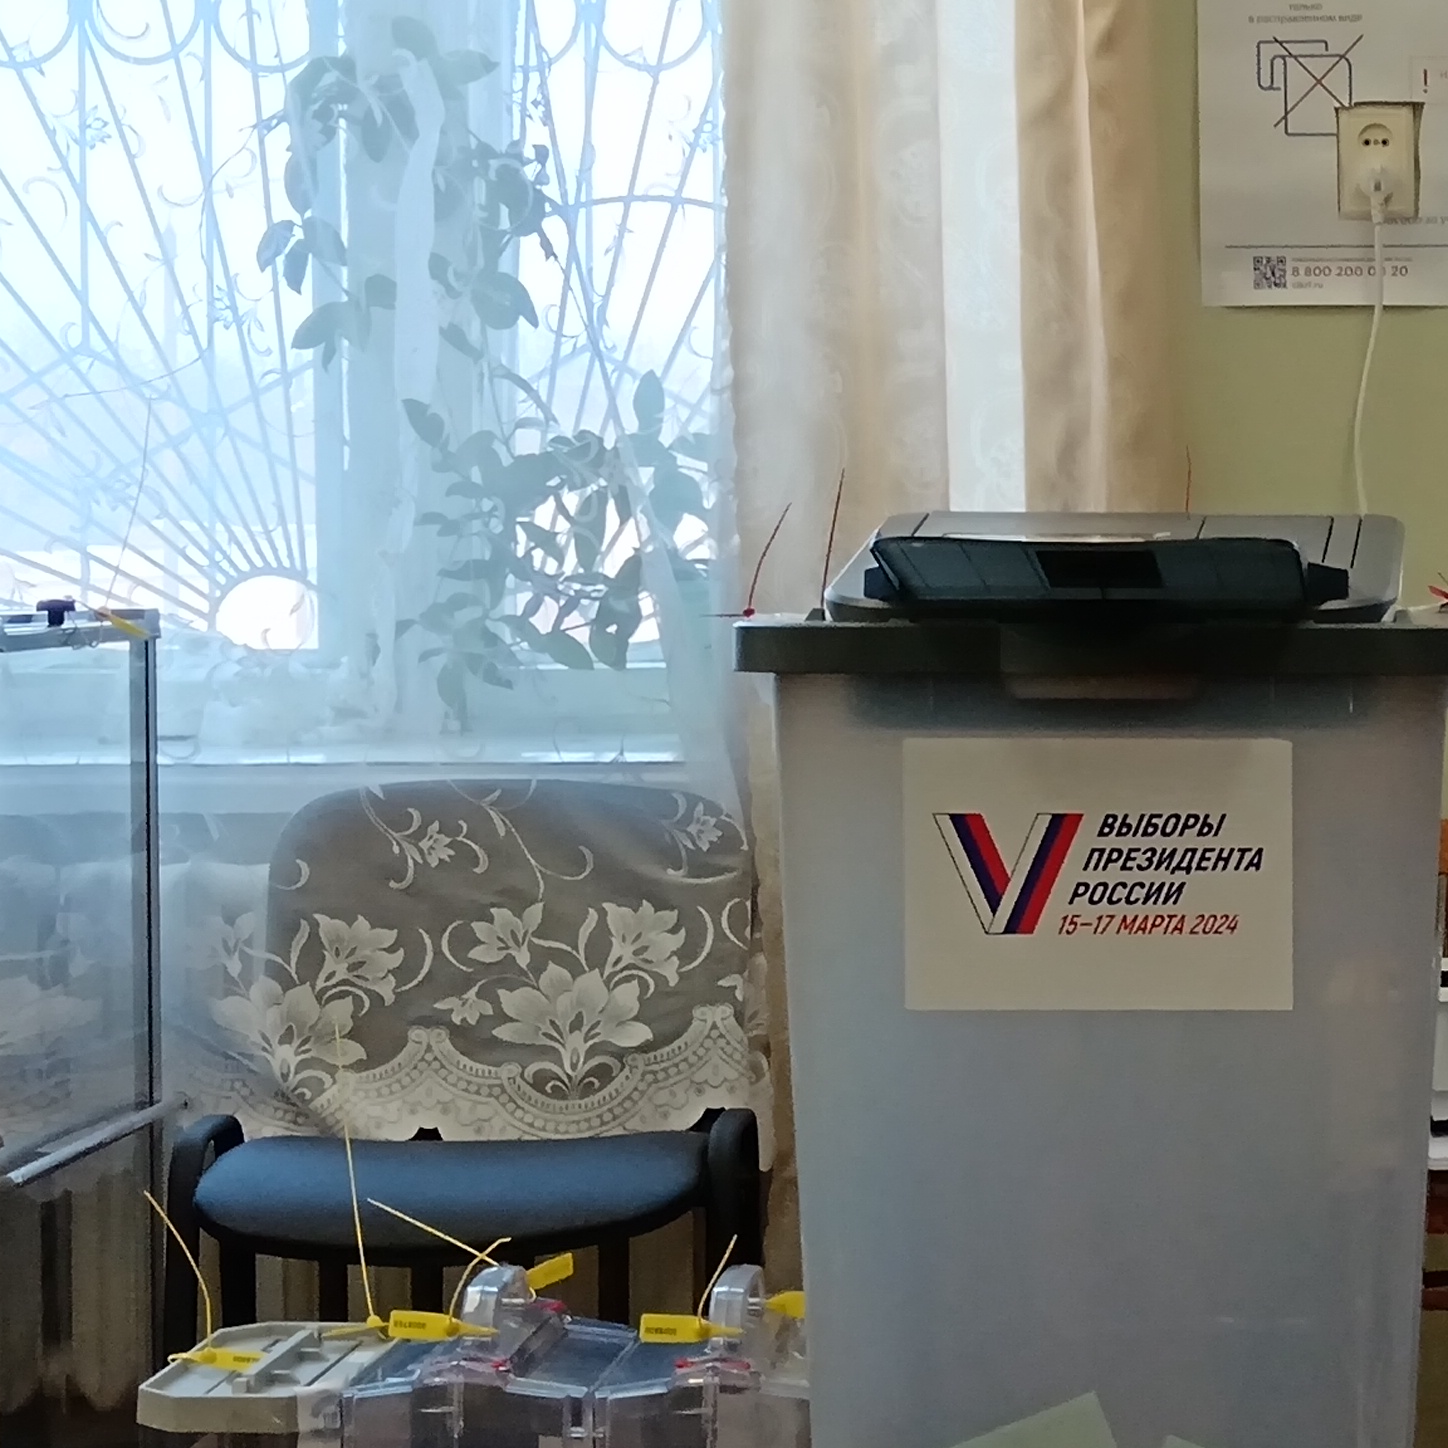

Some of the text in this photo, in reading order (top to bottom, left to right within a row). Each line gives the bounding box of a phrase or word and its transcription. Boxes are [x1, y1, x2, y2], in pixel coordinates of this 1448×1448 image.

[1291, 265, 1300, 277] 8
[1304, 265, 1332, 277] 800
[1335, 265, 1363, 277] 200
[1390, 265, 1409, 277] 20
[1096, 812, 1227, 838] ВЫБОРЫ
[1082, 847, 1264, 876] ПРЕЗИДЕНТА
[1068, 882, 1187, 905] РОССИИ
[1117, 915, 1187, 935] МАРТА
[1189, 915, 1240, 935] 2024
